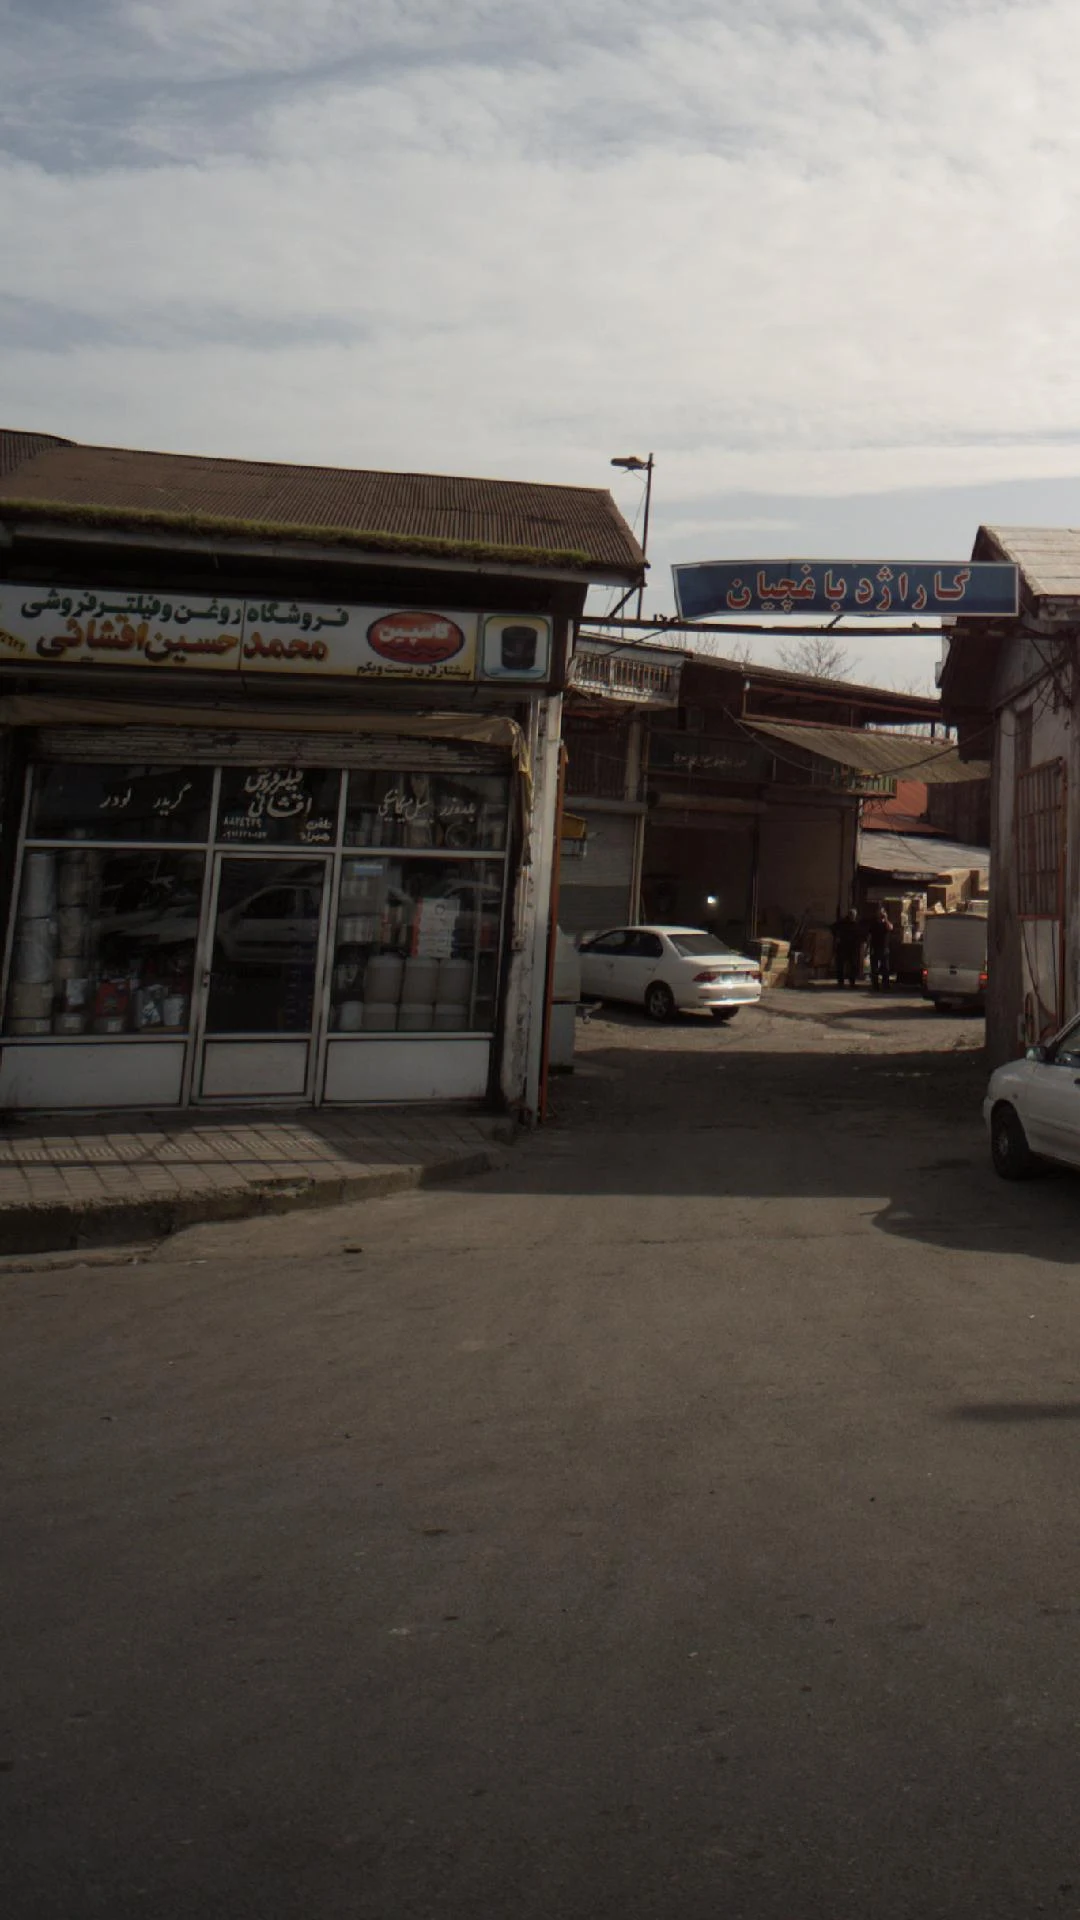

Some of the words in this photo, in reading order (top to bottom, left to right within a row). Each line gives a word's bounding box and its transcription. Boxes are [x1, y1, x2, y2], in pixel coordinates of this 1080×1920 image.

[174, 597, 241, 625] روغن
[247, 602, 349, 631] فروشگاه
[145, 632, 239, 663] حسین
[242, 632, 328, 661] محمد
[99, 787, 132, 808] لودر
[152, 782, 192, 816] گریدر
